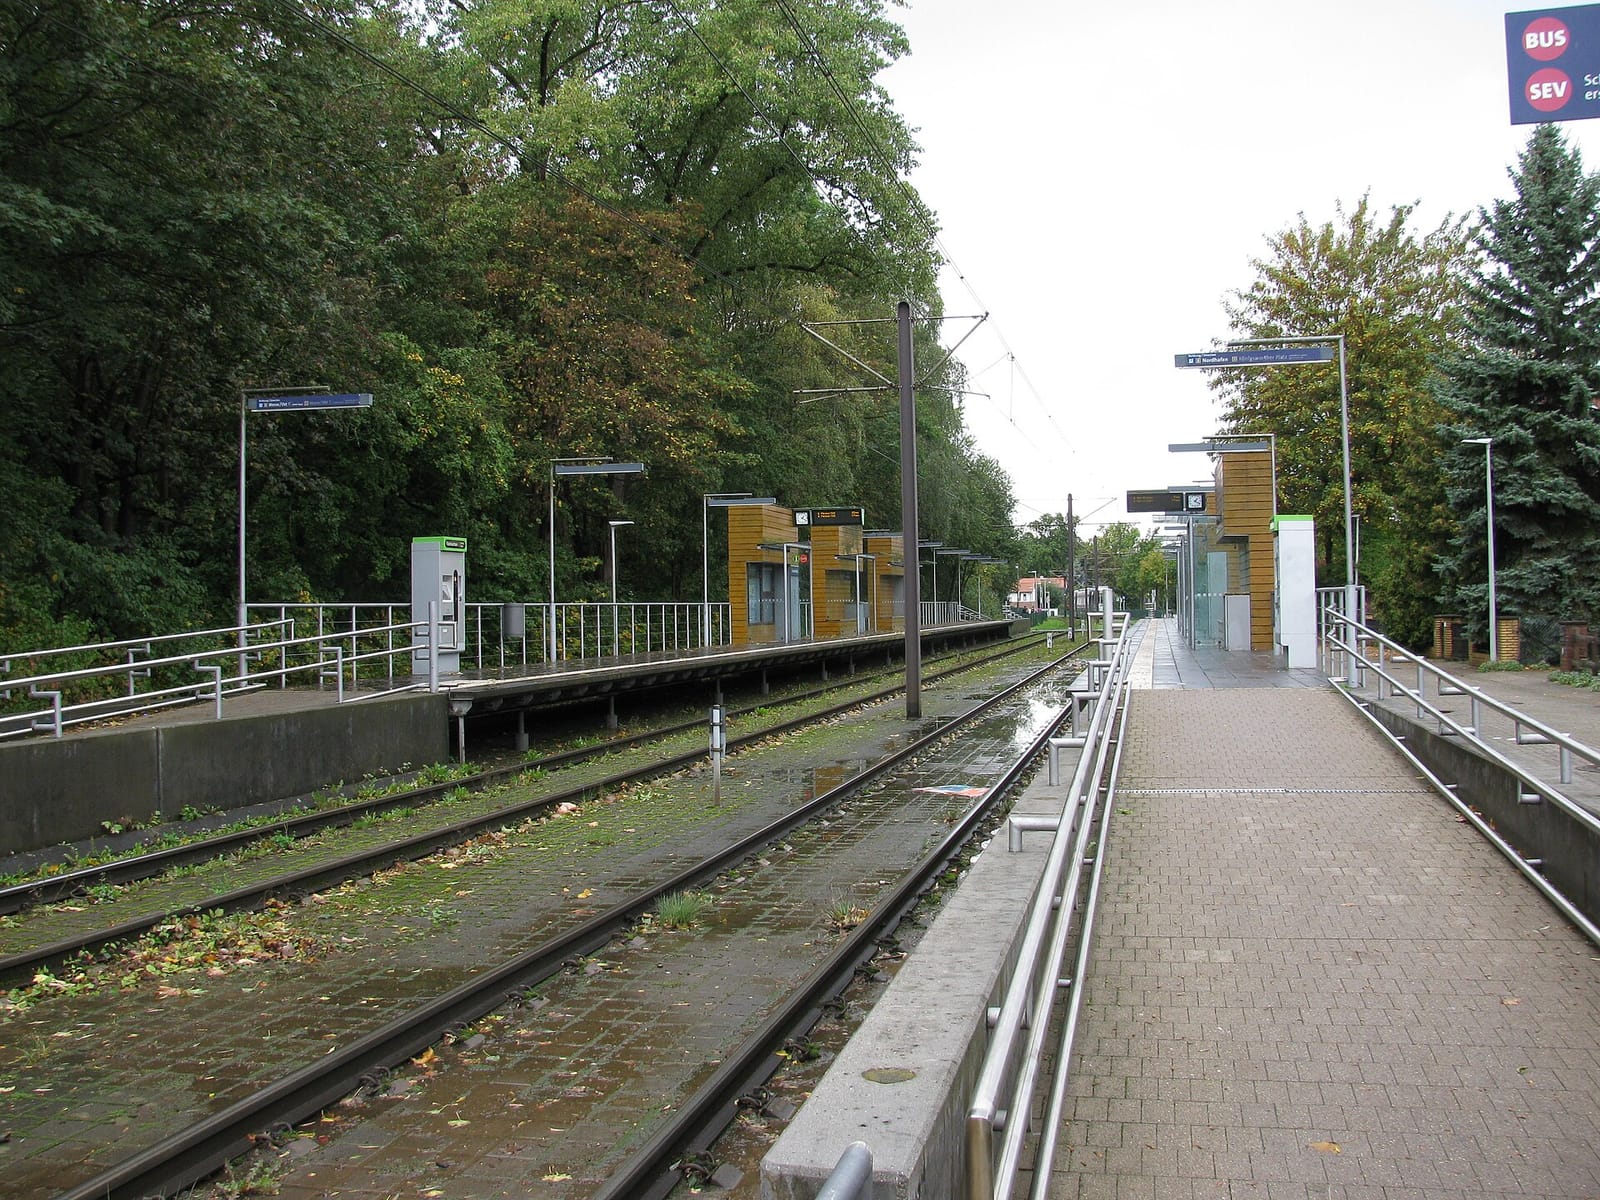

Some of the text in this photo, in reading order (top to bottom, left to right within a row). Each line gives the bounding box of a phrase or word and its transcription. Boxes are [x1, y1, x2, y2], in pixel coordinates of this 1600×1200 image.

[1525, 29, 1567, 49] BUS
[1529, 80, 1567, 100] SEV
[1584, 73, 1600, 87] Sc
